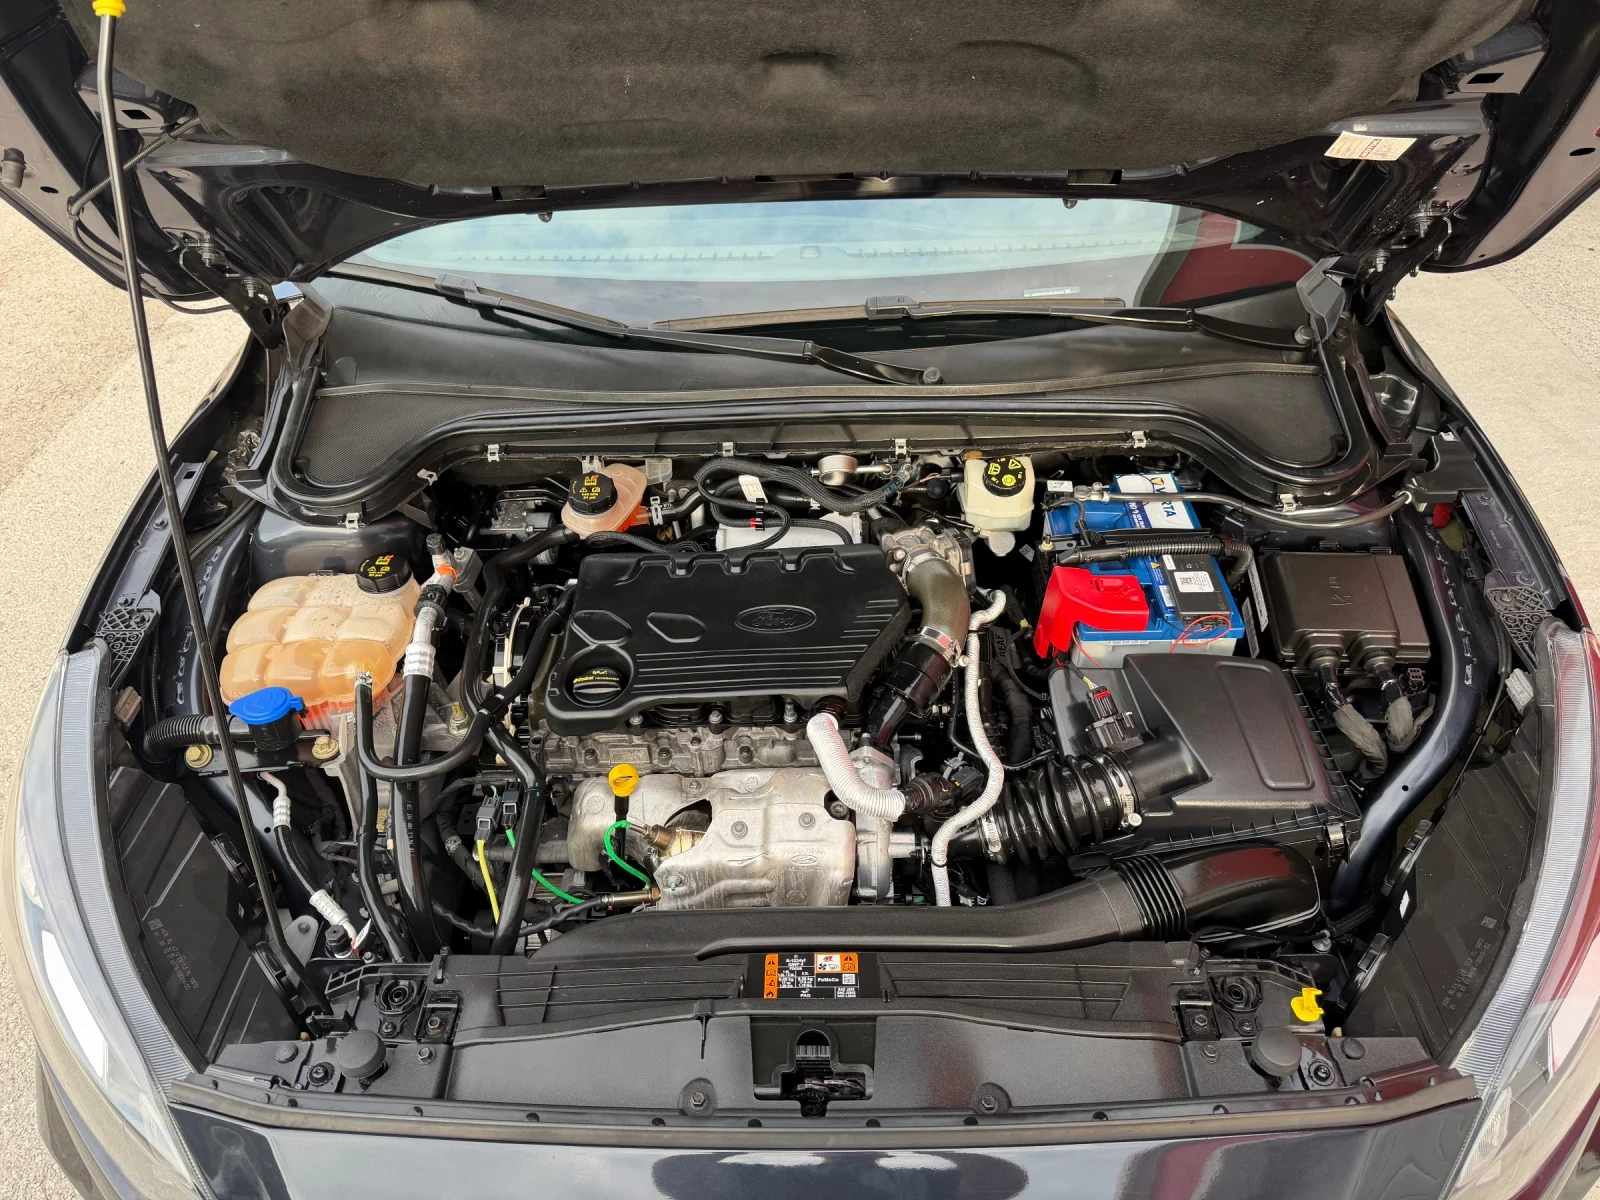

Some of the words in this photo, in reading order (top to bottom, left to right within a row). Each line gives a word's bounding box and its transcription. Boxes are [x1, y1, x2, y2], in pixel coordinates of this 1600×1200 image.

[1359, 139, 1381, 157] MOTUL
[1155, 486, 1177, 518] VRTA
[752, 611, 798, 627] Ford
